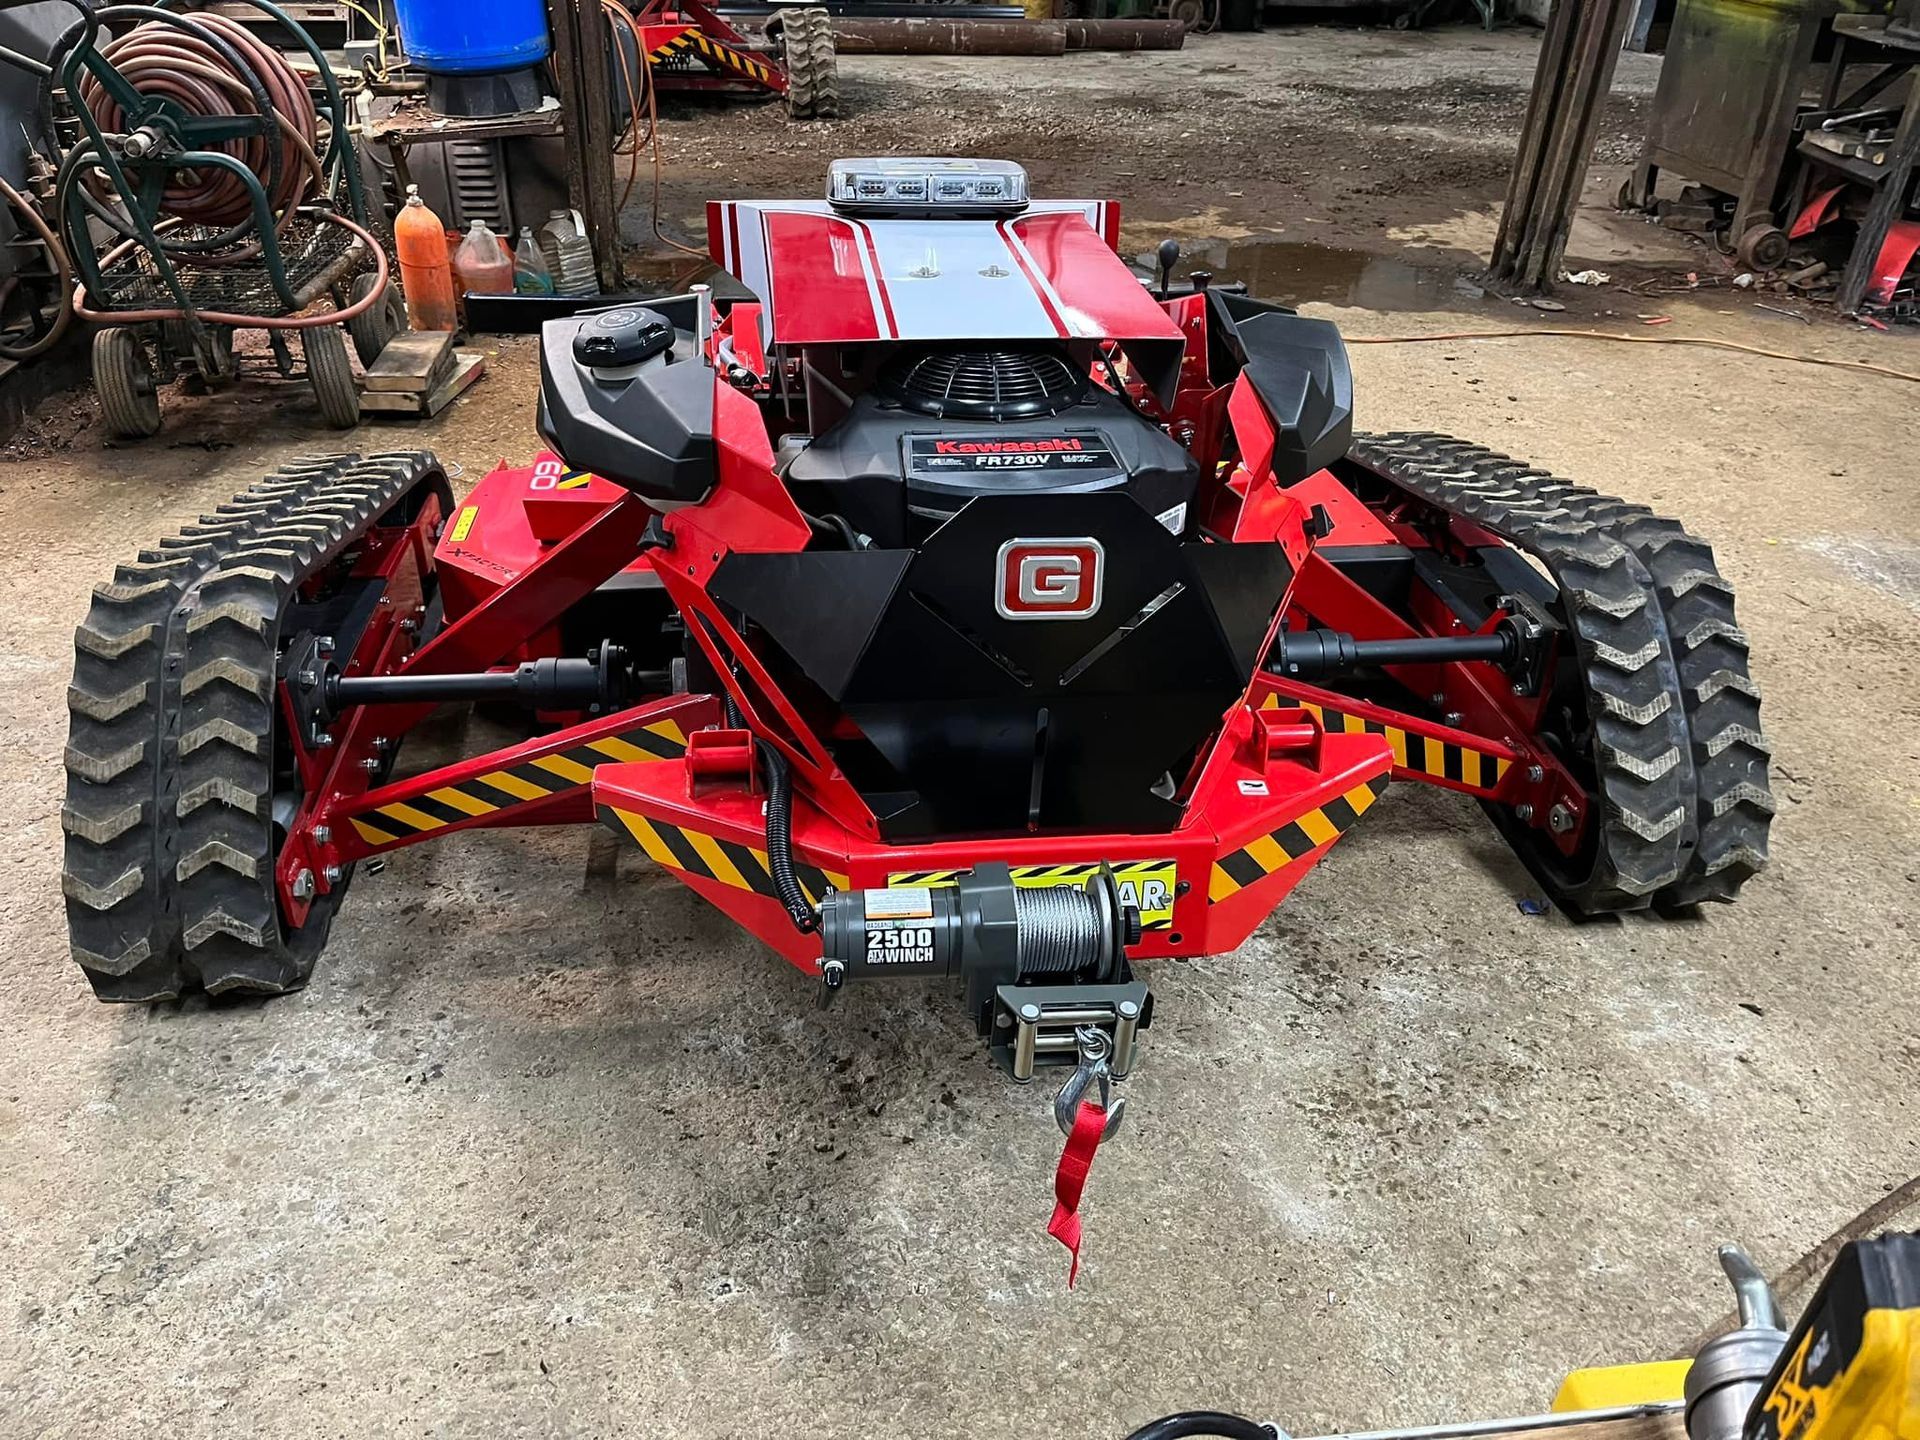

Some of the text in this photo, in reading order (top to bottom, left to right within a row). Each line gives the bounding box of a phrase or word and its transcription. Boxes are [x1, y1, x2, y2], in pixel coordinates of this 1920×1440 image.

[935, 438, 1082, 454] Kawasaki
[975, 454, 1051, 466] FR730V
[529, 460, 562, 491] 60
[867, 928, 932, 949] 2500
[885, 946, 934, 963] WINCH
